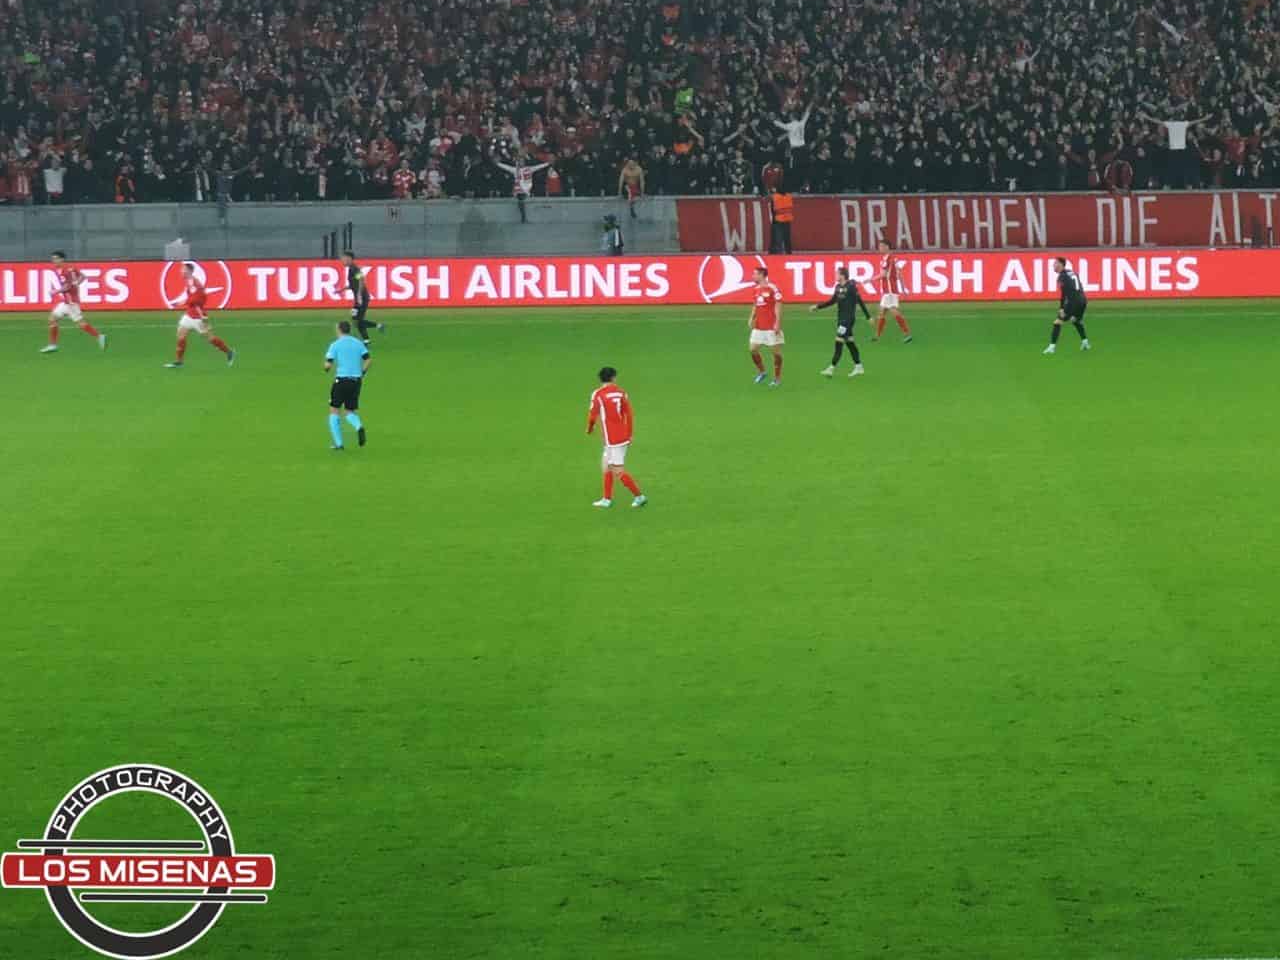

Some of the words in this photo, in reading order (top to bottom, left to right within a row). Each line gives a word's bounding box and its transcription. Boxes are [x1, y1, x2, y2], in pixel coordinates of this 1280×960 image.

[719, 200, 774, 253] WI
[840, 199, 1047, 250] BRAUCHEN
[1096, 196, 1157, 247] DIE
[464, 262, 670, 299] AIRLINES
